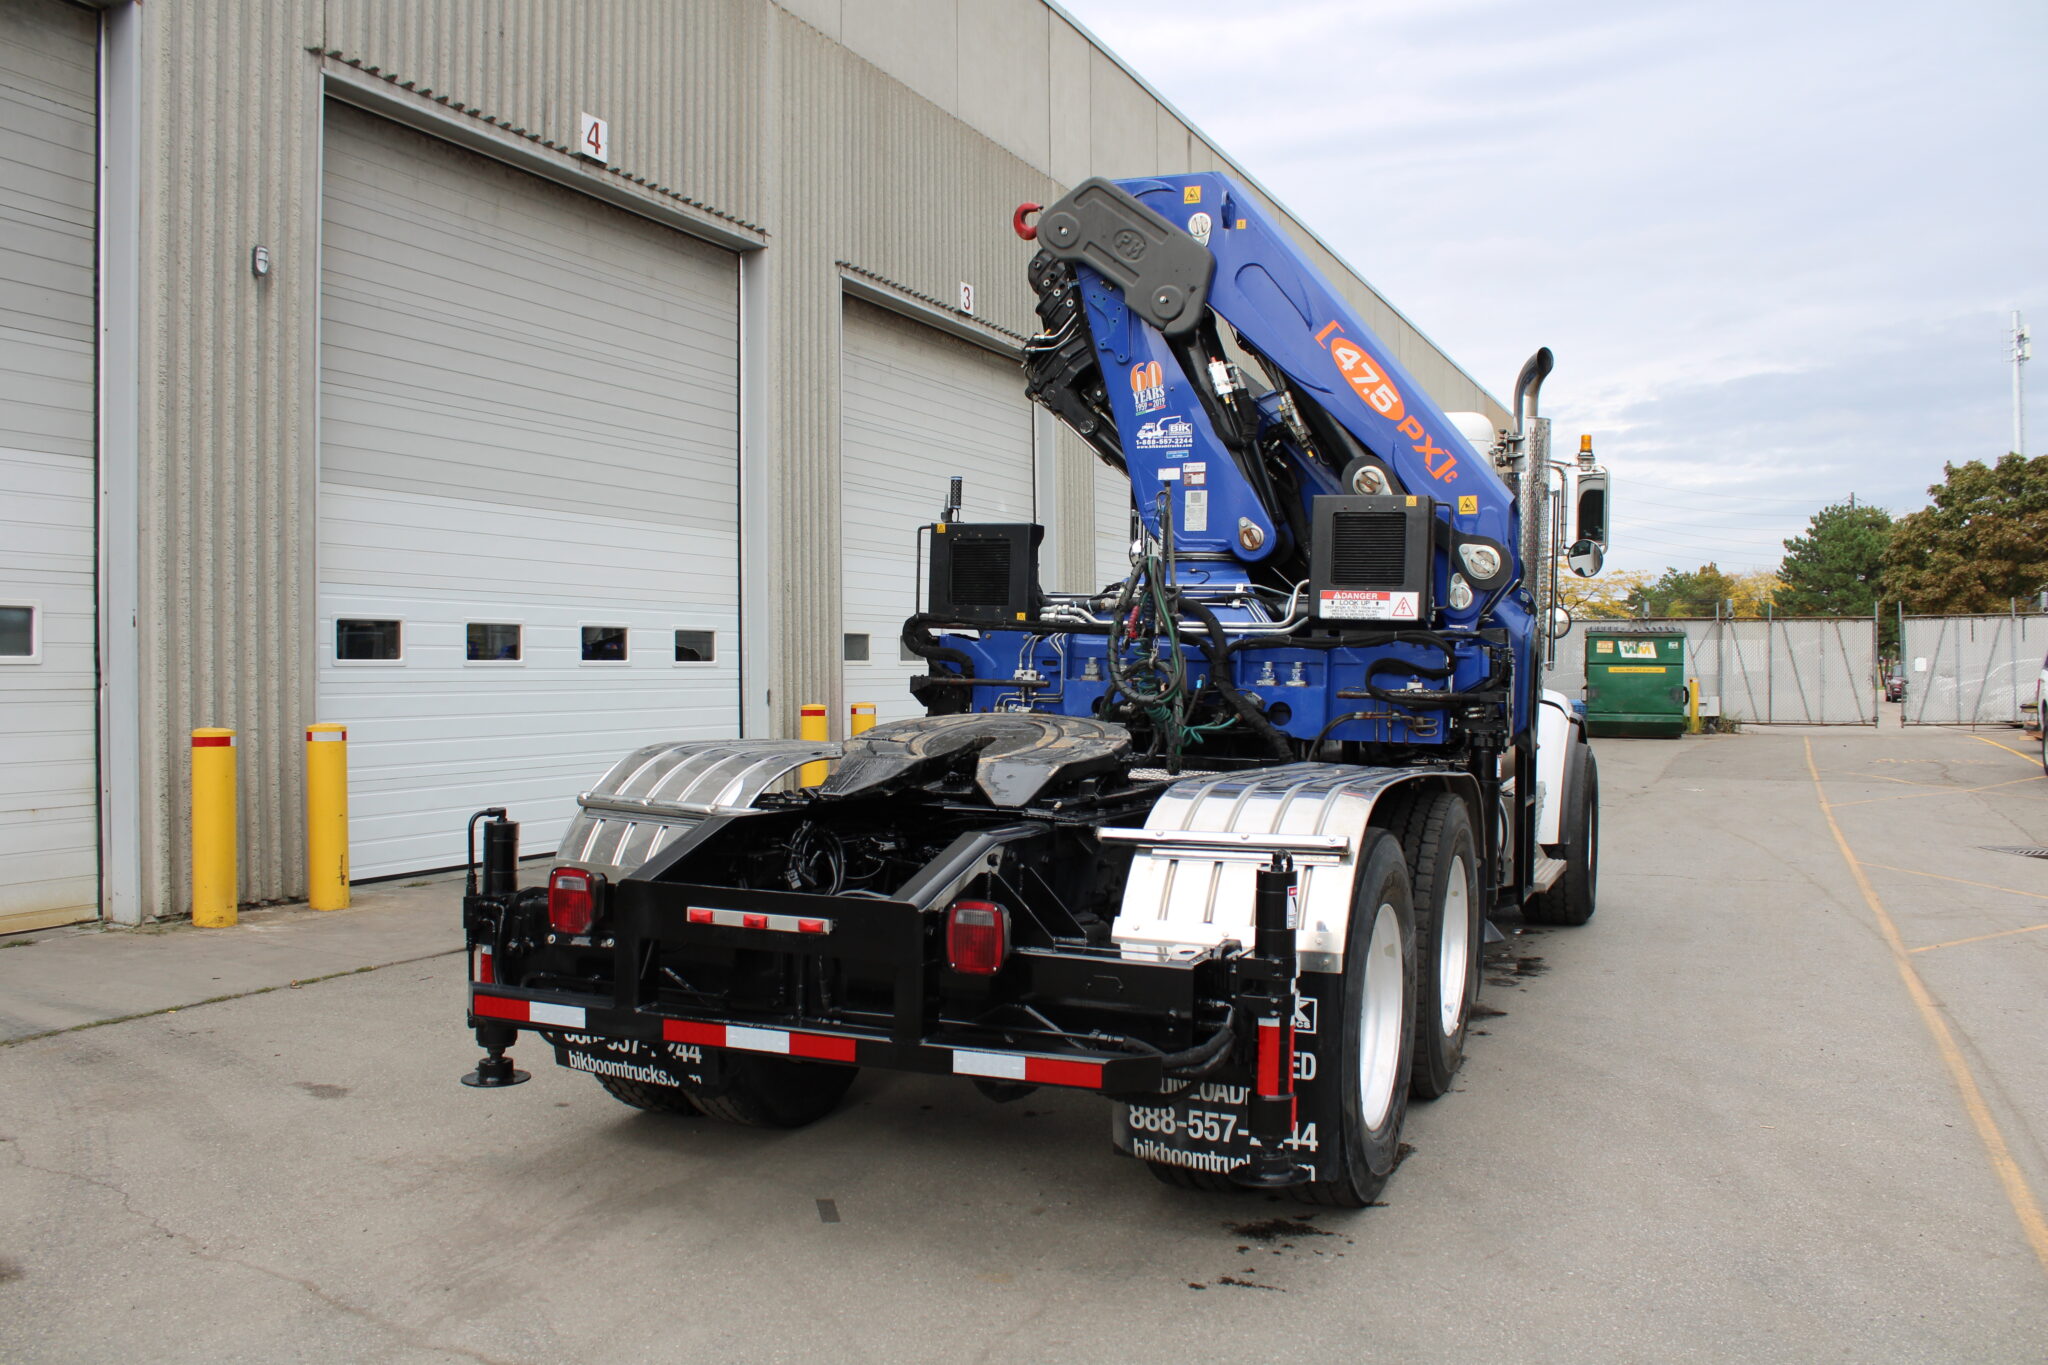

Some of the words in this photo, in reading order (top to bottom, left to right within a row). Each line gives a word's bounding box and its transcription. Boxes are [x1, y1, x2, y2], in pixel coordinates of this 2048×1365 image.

[587, 121, 601, 155] 4
[963, 286, 971, 310] 3
[1131, 361, 1162, 392] 60
[1134, 385, 1165, 404] YEARS
[1170, 424, 1190, 432] BIK
[1341, 592, 1378, 600] DANGER
[1624, 645, 1651, 654] WM
[1129, 1103, 1319, 1152] 888-557-44
